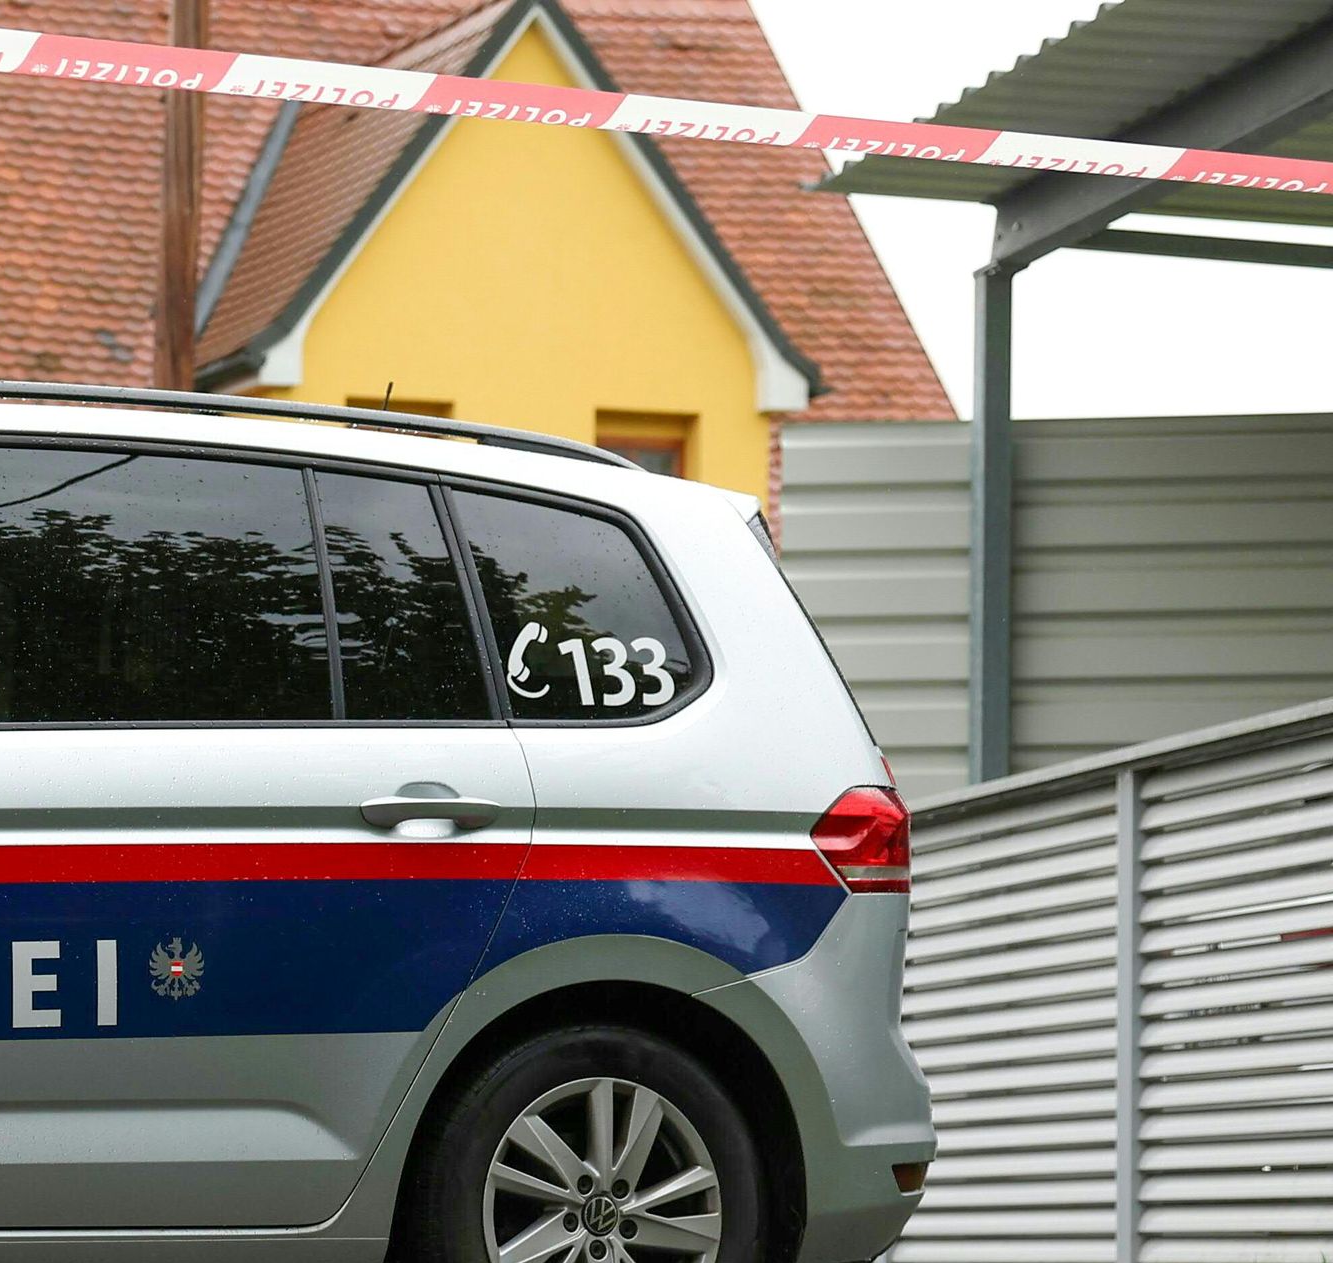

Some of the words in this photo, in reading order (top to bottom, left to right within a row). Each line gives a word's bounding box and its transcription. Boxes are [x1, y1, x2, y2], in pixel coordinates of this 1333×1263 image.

[55, 58, 204, 90] POLIZEI
[253, 80, 400, 108] POLIZEI
[447, 99, 593, 128] POLIZEI
[637, 119, 781, 145] POLIZEI
[826, 136, 966, 162] POLIZEI
[557, 637, 675, 707] 133
